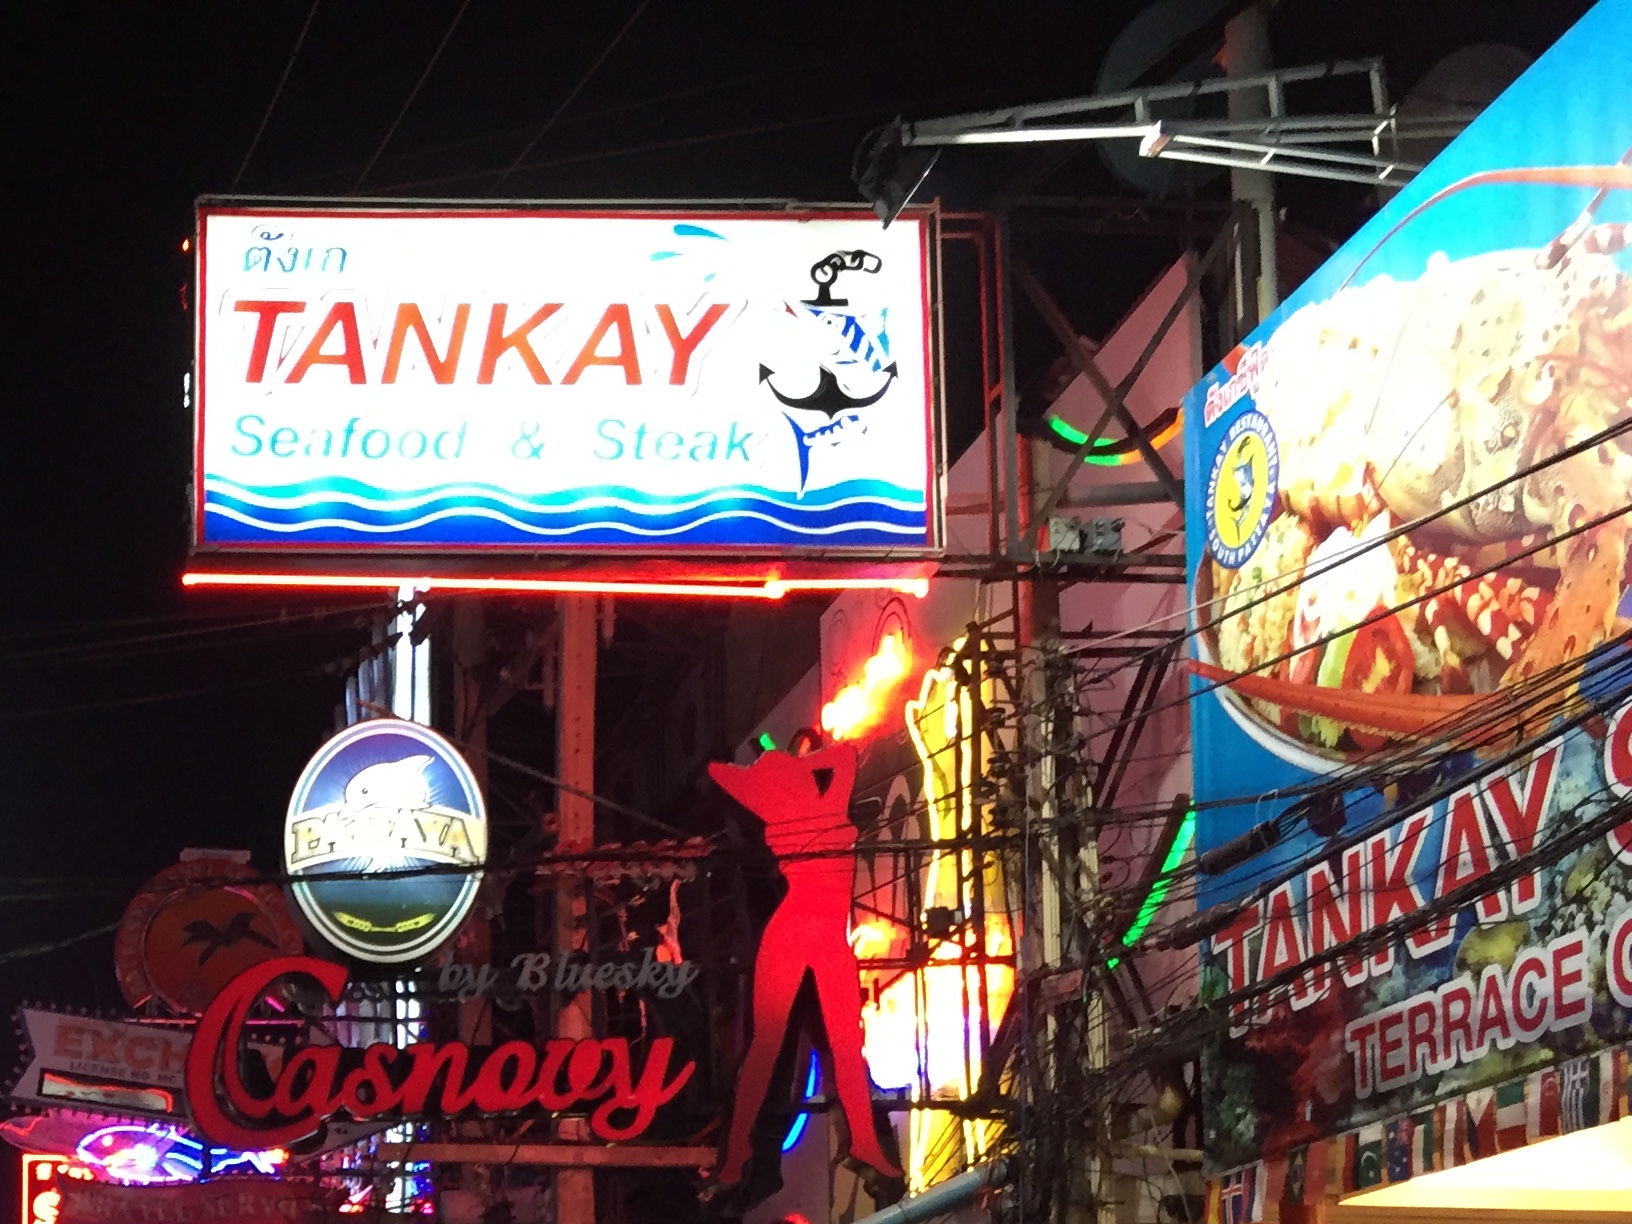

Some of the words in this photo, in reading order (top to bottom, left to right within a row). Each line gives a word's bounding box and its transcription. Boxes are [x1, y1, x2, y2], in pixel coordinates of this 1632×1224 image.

[233, 299, 731, 386] TANKAY
[230, 413, 467, 462] Seafood
[510, 423, 546, 460] &
[592, 418, 755, 463] Steak
[1229, 412, 1279, 475] RESTAURANT
[1209, 530, 1236, 567] SOUTH
[290, 808, 481, 867] PAAYA
[1211, 738, 1561, 1036] TANKAY
[437, 950, 499, 998] by
[511, 946, 700, 998] Bluesky
[1348, 934, 1590, 1094] TERRACE
